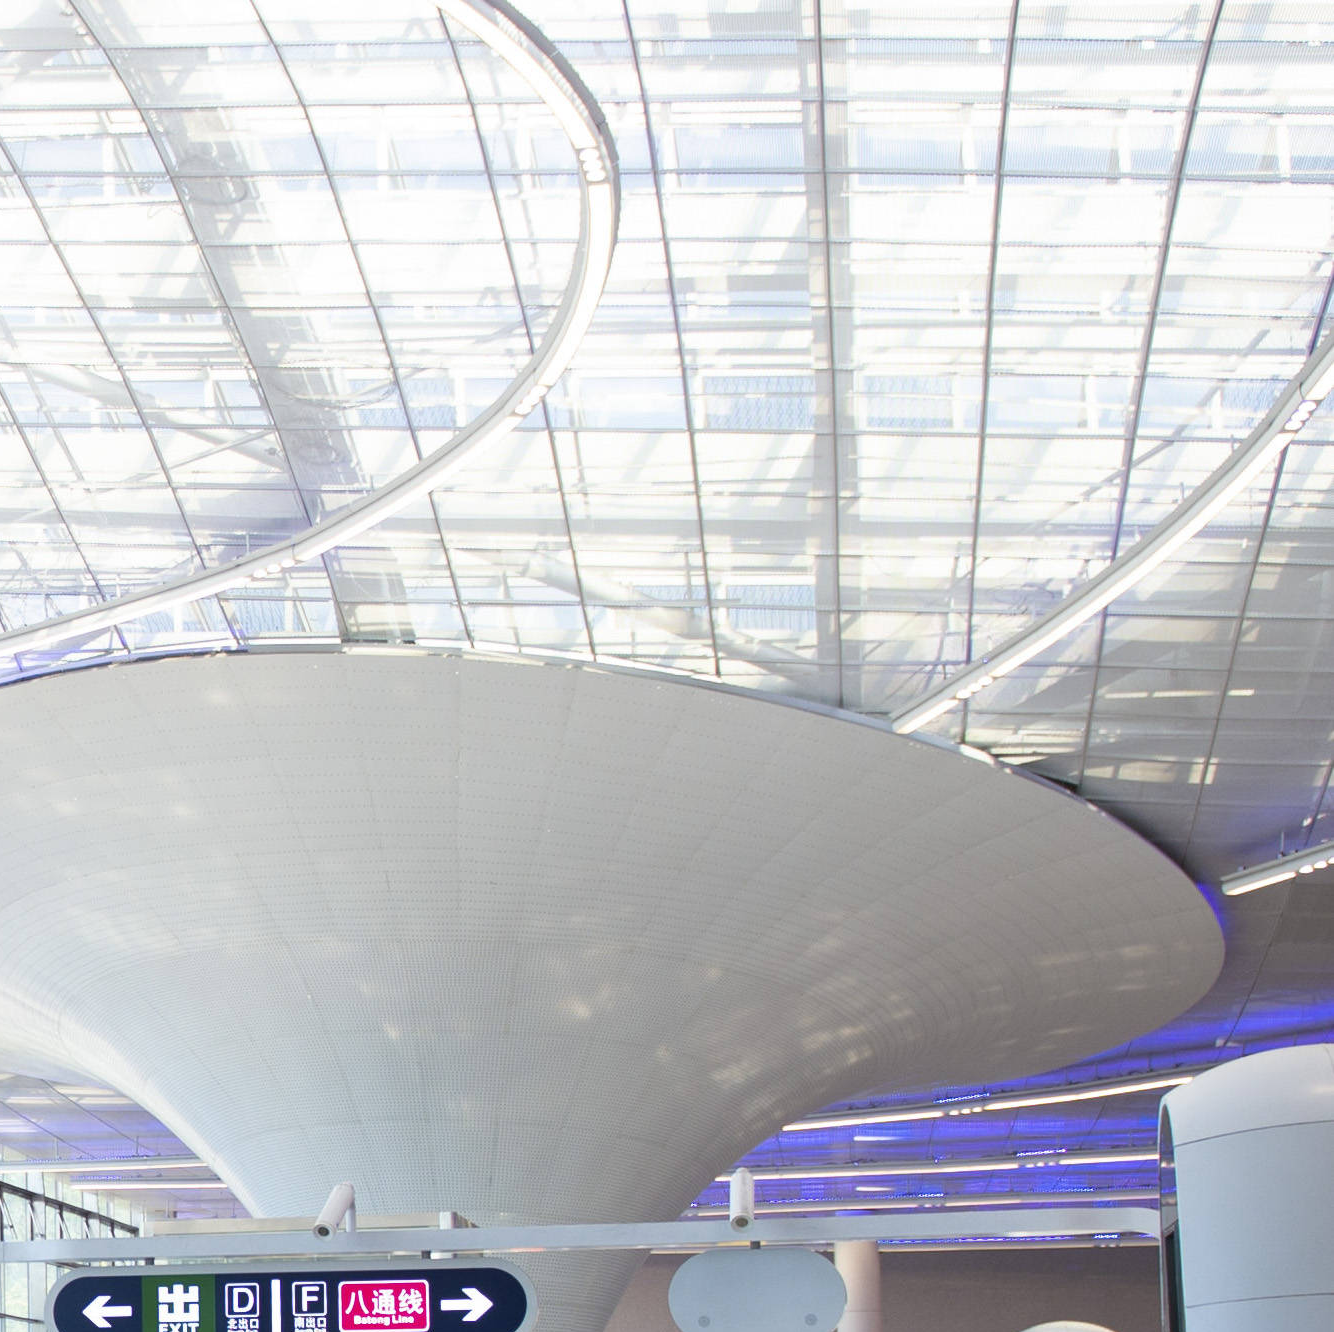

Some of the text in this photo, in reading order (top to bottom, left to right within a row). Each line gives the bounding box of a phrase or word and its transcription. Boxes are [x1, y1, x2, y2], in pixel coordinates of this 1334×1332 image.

[158, 1284, 199, 1322] 出
[232, 1287, 254, 1313] D
[301, 1286, 320, 1312] F
[345, 1288, 424, 1315] 八通线
[227, 1317, 259, 1330] 北出口
[354, 1314, 415, 1326] Batong Line
